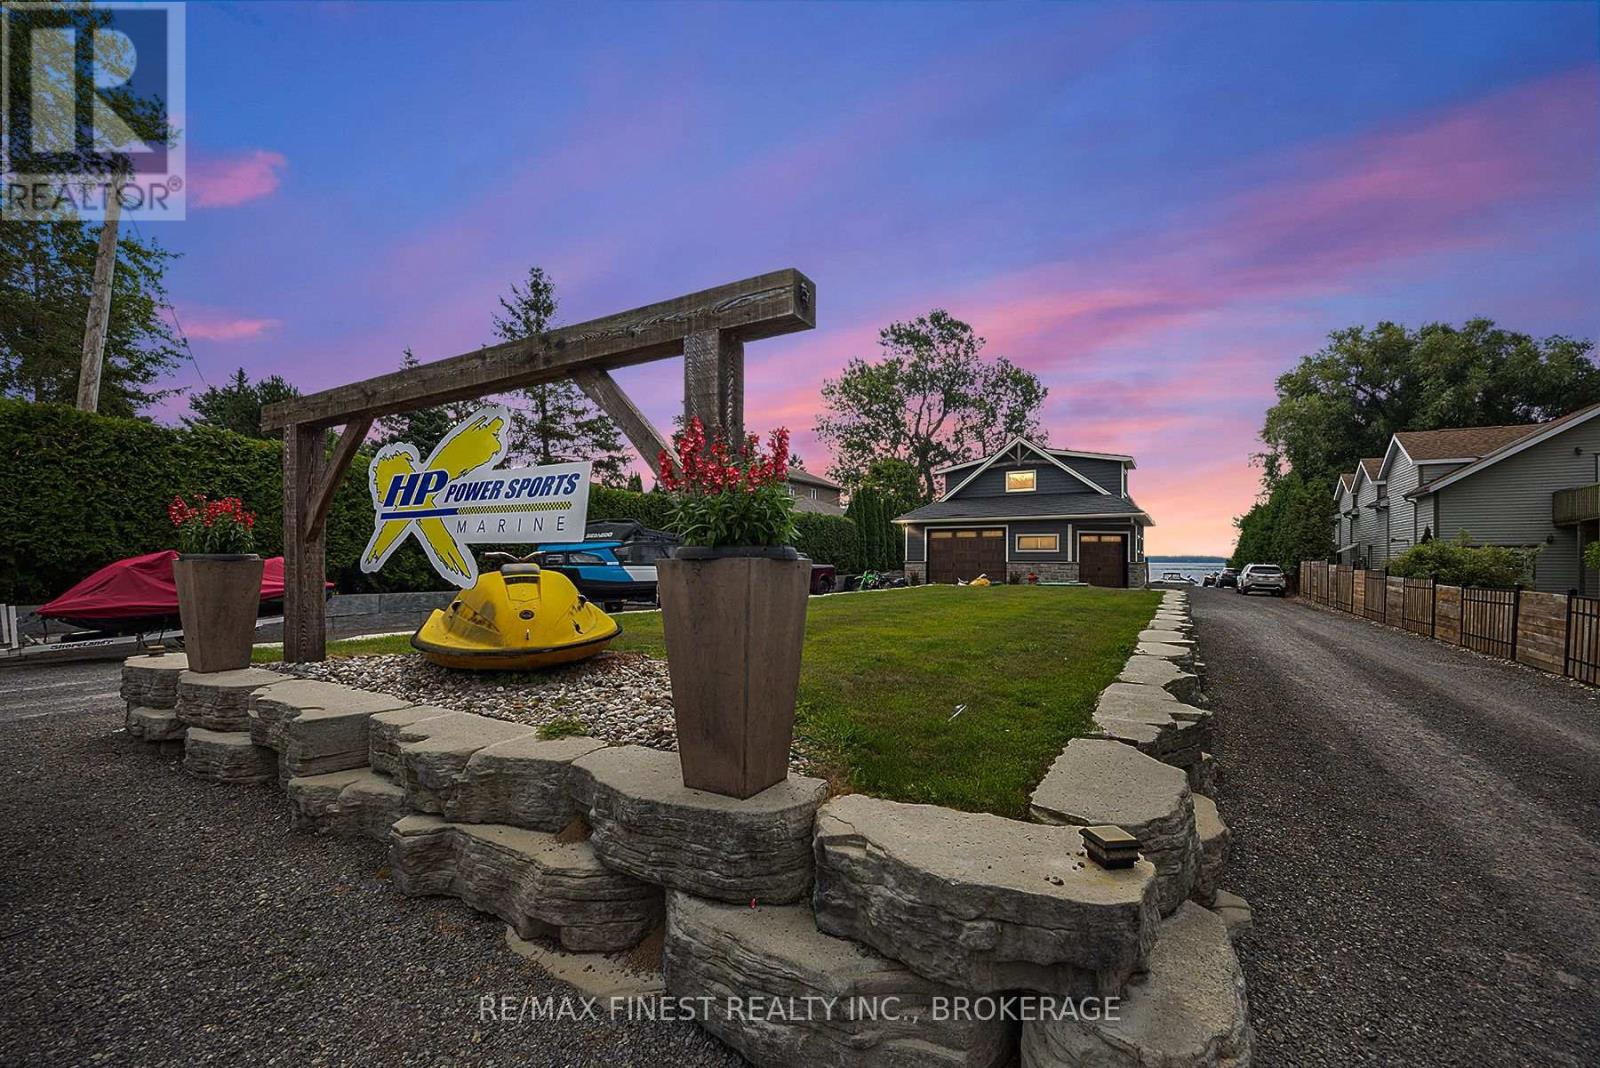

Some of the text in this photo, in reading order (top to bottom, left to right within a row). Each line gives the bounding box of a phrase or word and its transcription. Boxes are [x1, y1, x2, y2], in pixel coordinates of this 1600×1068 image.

[383, 470, 581, 508] HP POWER SPORTS
[456, 515, 566, 534] MARINE
